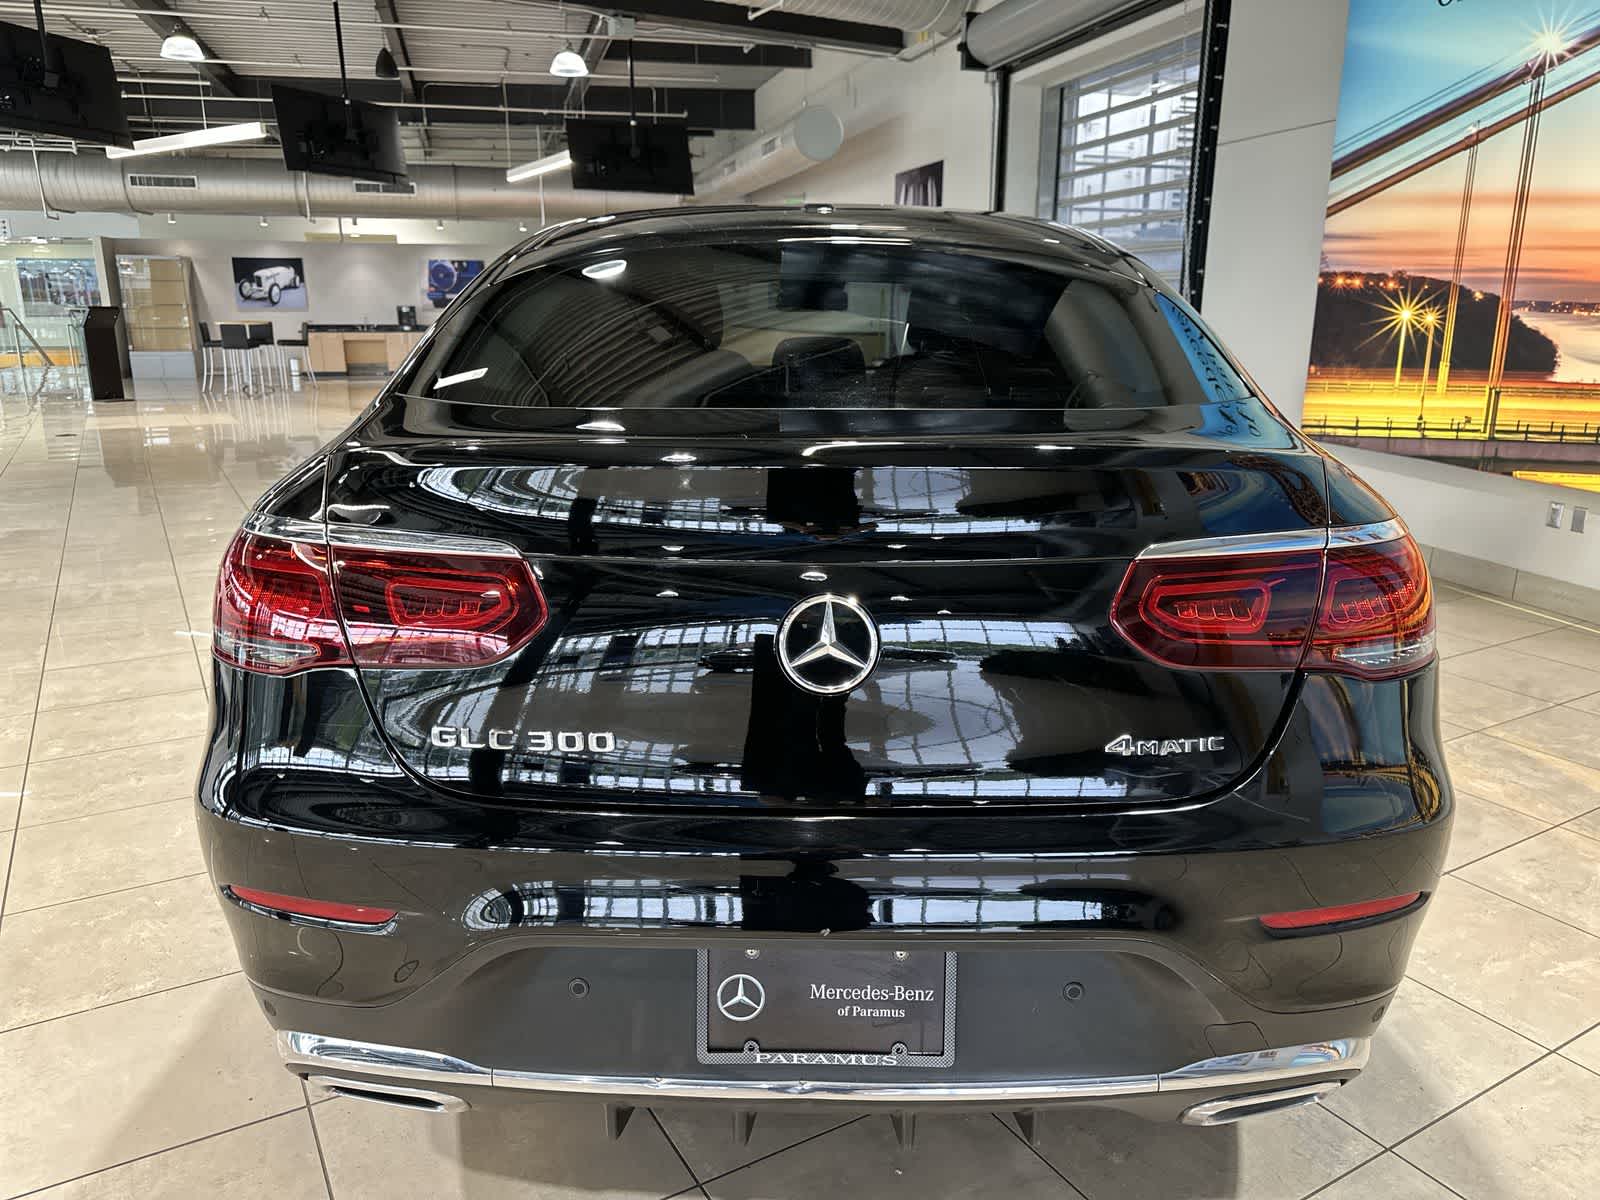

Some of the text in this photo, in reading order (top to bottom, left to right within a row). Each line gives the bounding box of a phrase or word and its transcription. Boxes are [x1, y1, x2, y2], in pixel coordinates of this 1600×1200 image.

[431, 726, 616, 752] GLC 300
[1104, 734, 1225, 757] 4MATIC
[810, 984, 935, 1001] Mercedes-Benz
[837, 1006, 906, 1018] of Paramus
[752, 1053, 899, 1066] PARAMUS
